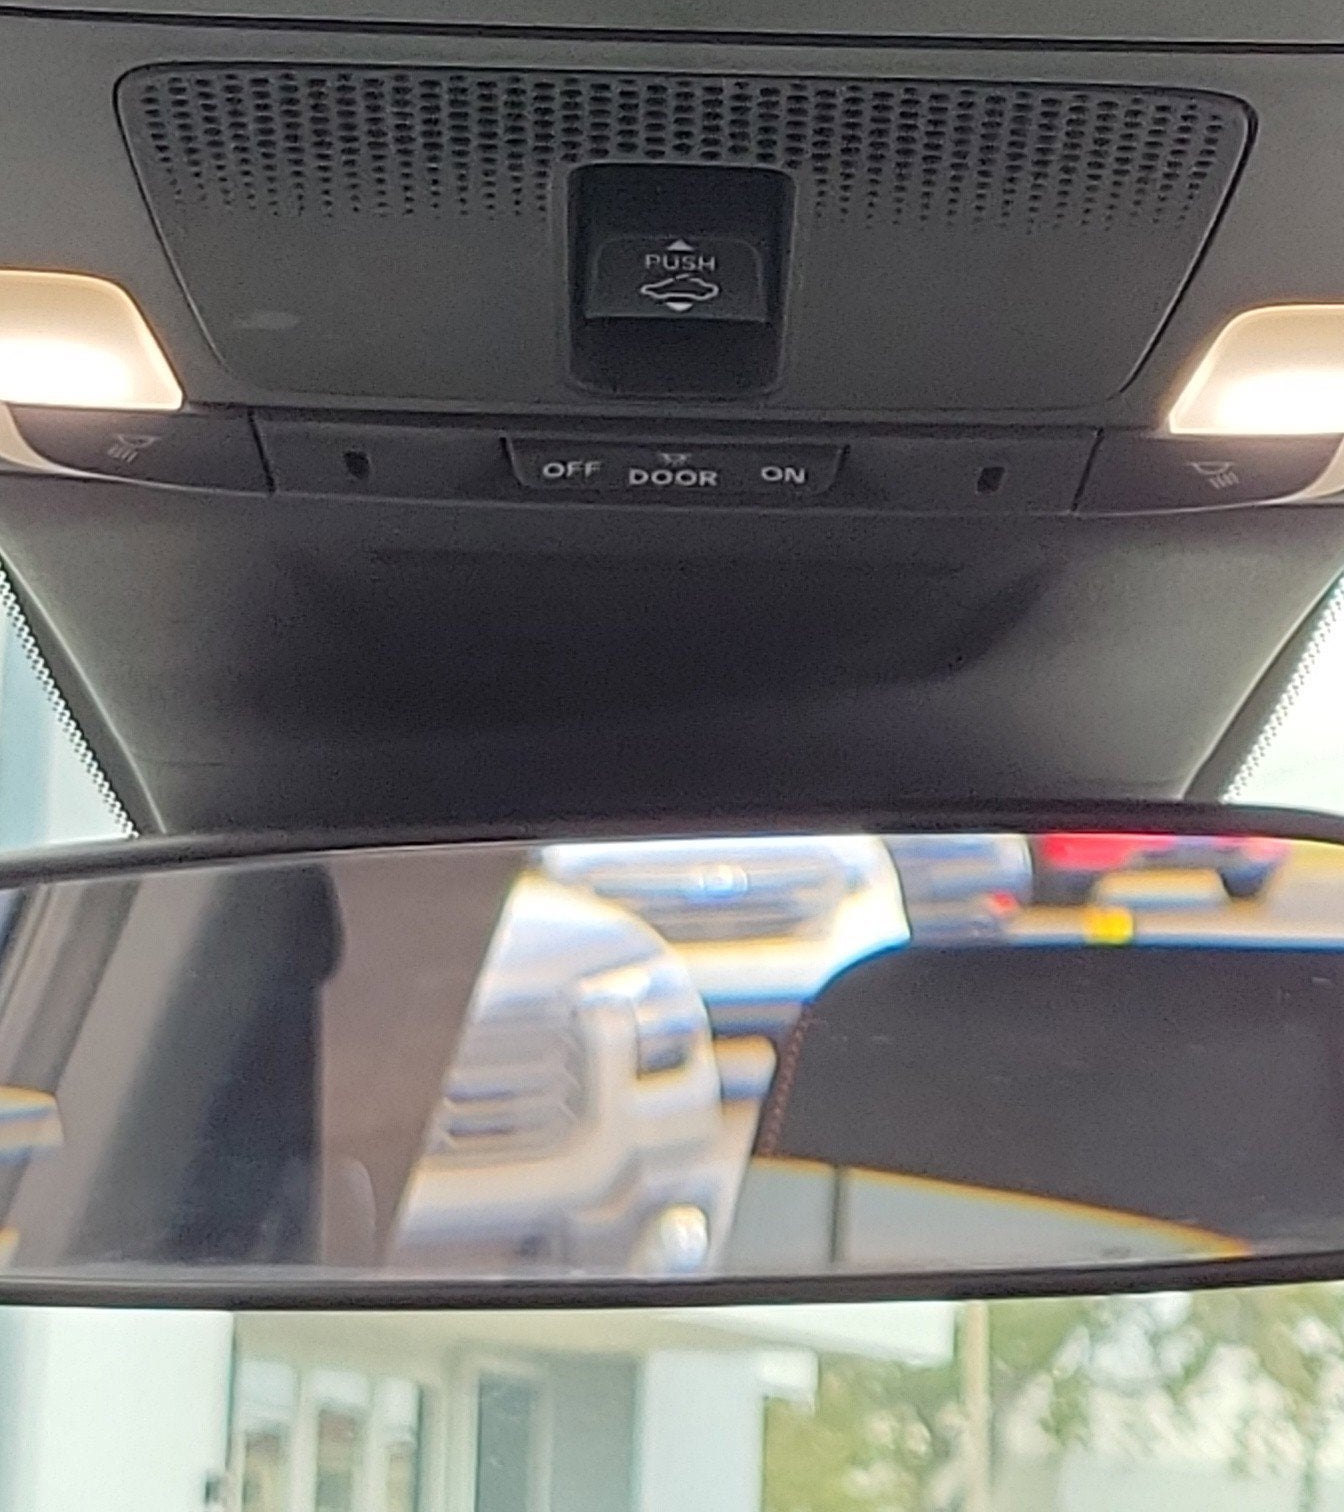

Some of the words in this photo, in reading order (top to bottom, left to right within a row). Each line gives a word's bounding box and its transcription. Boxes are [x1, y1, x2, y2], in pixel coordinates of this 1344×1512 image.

[644, 254, 716, 271] PUSH
[542, 461, 602, 479] OFF
[628, 468, 719, 487] DOOR
[760, 466, 806, 484] ON
